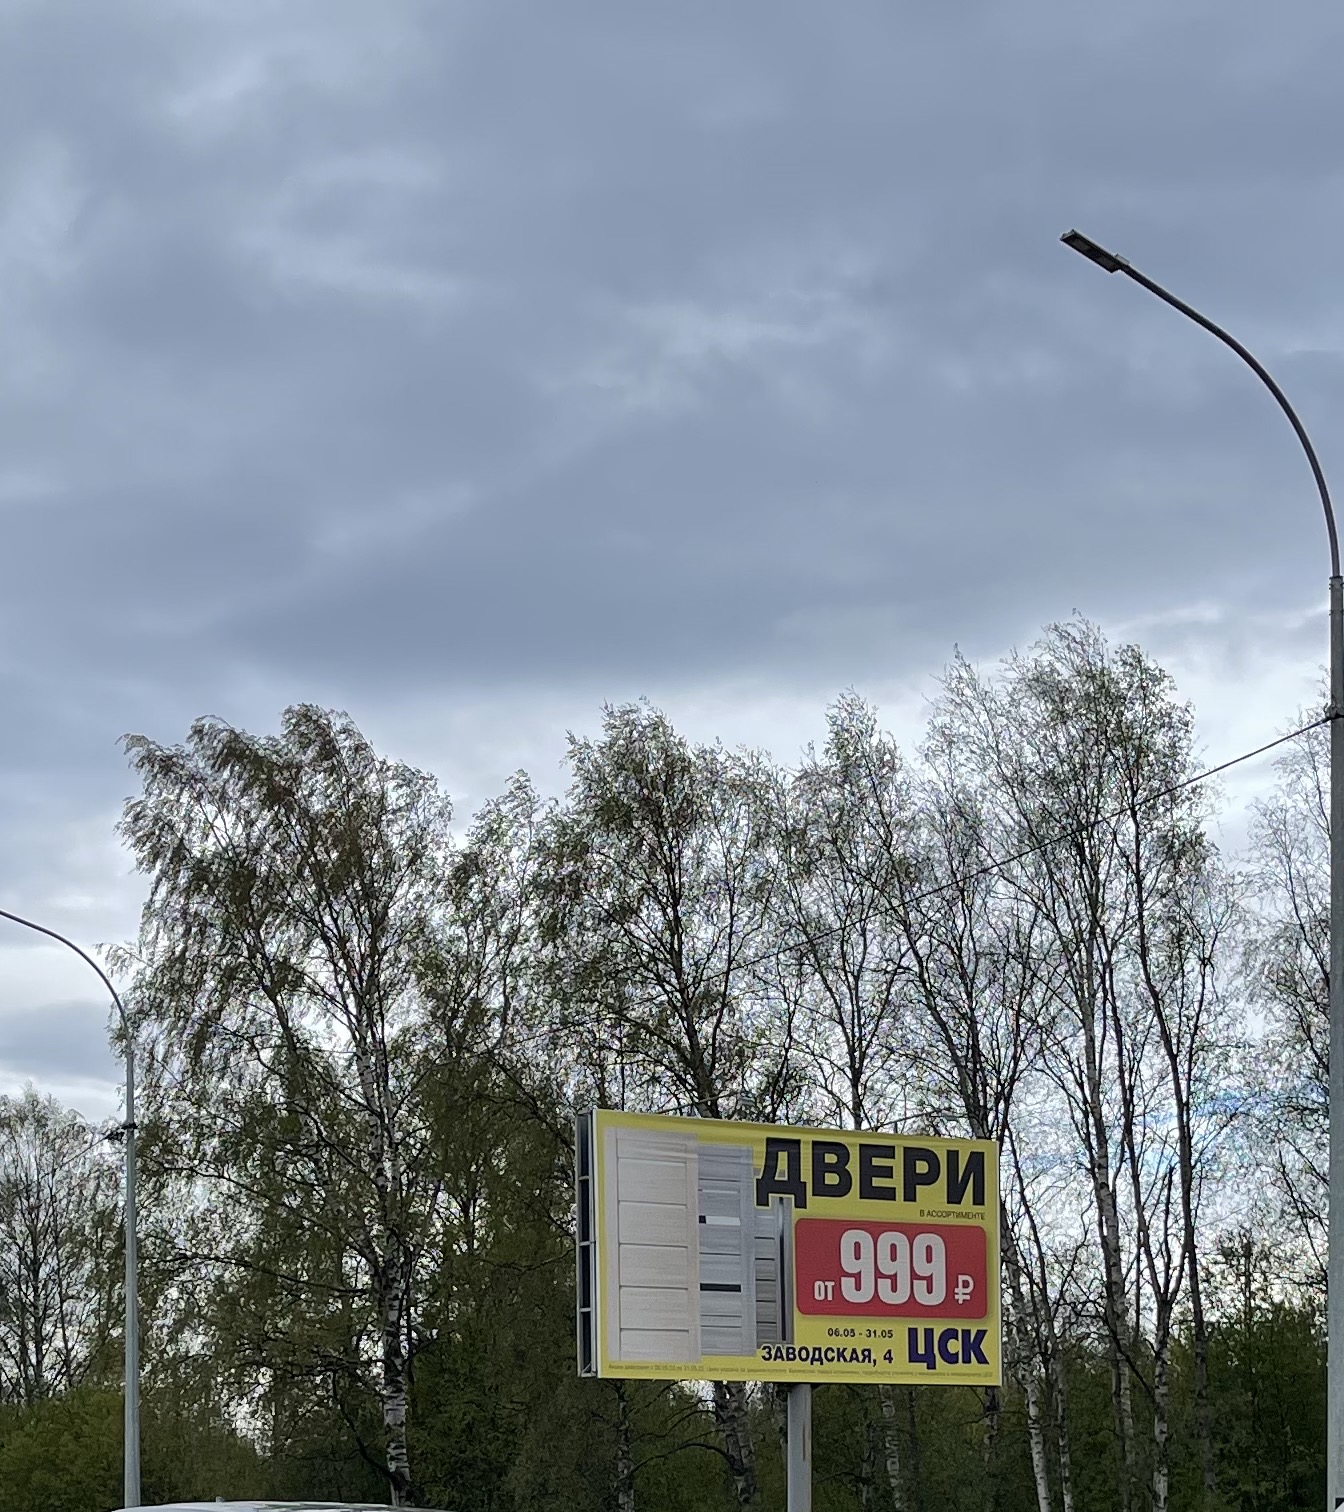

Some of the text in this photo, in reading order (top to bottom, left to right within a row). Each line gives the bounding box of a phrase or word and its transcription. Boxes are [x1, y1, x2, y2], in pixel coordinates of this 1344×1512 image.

[755, 1137, 986, 1209] ДВЕРИ
[919, 1209, 986, 1220] В АССОРТИМЕНТЕ
[840, 1229, 947, 1306] 999
[865, 1328, 894, 1339] 31.05
[907, 1327, 990, 1370] ЦСК
[761, 1345, 894, 1367] ЗАВОДСКАЯ, 4
